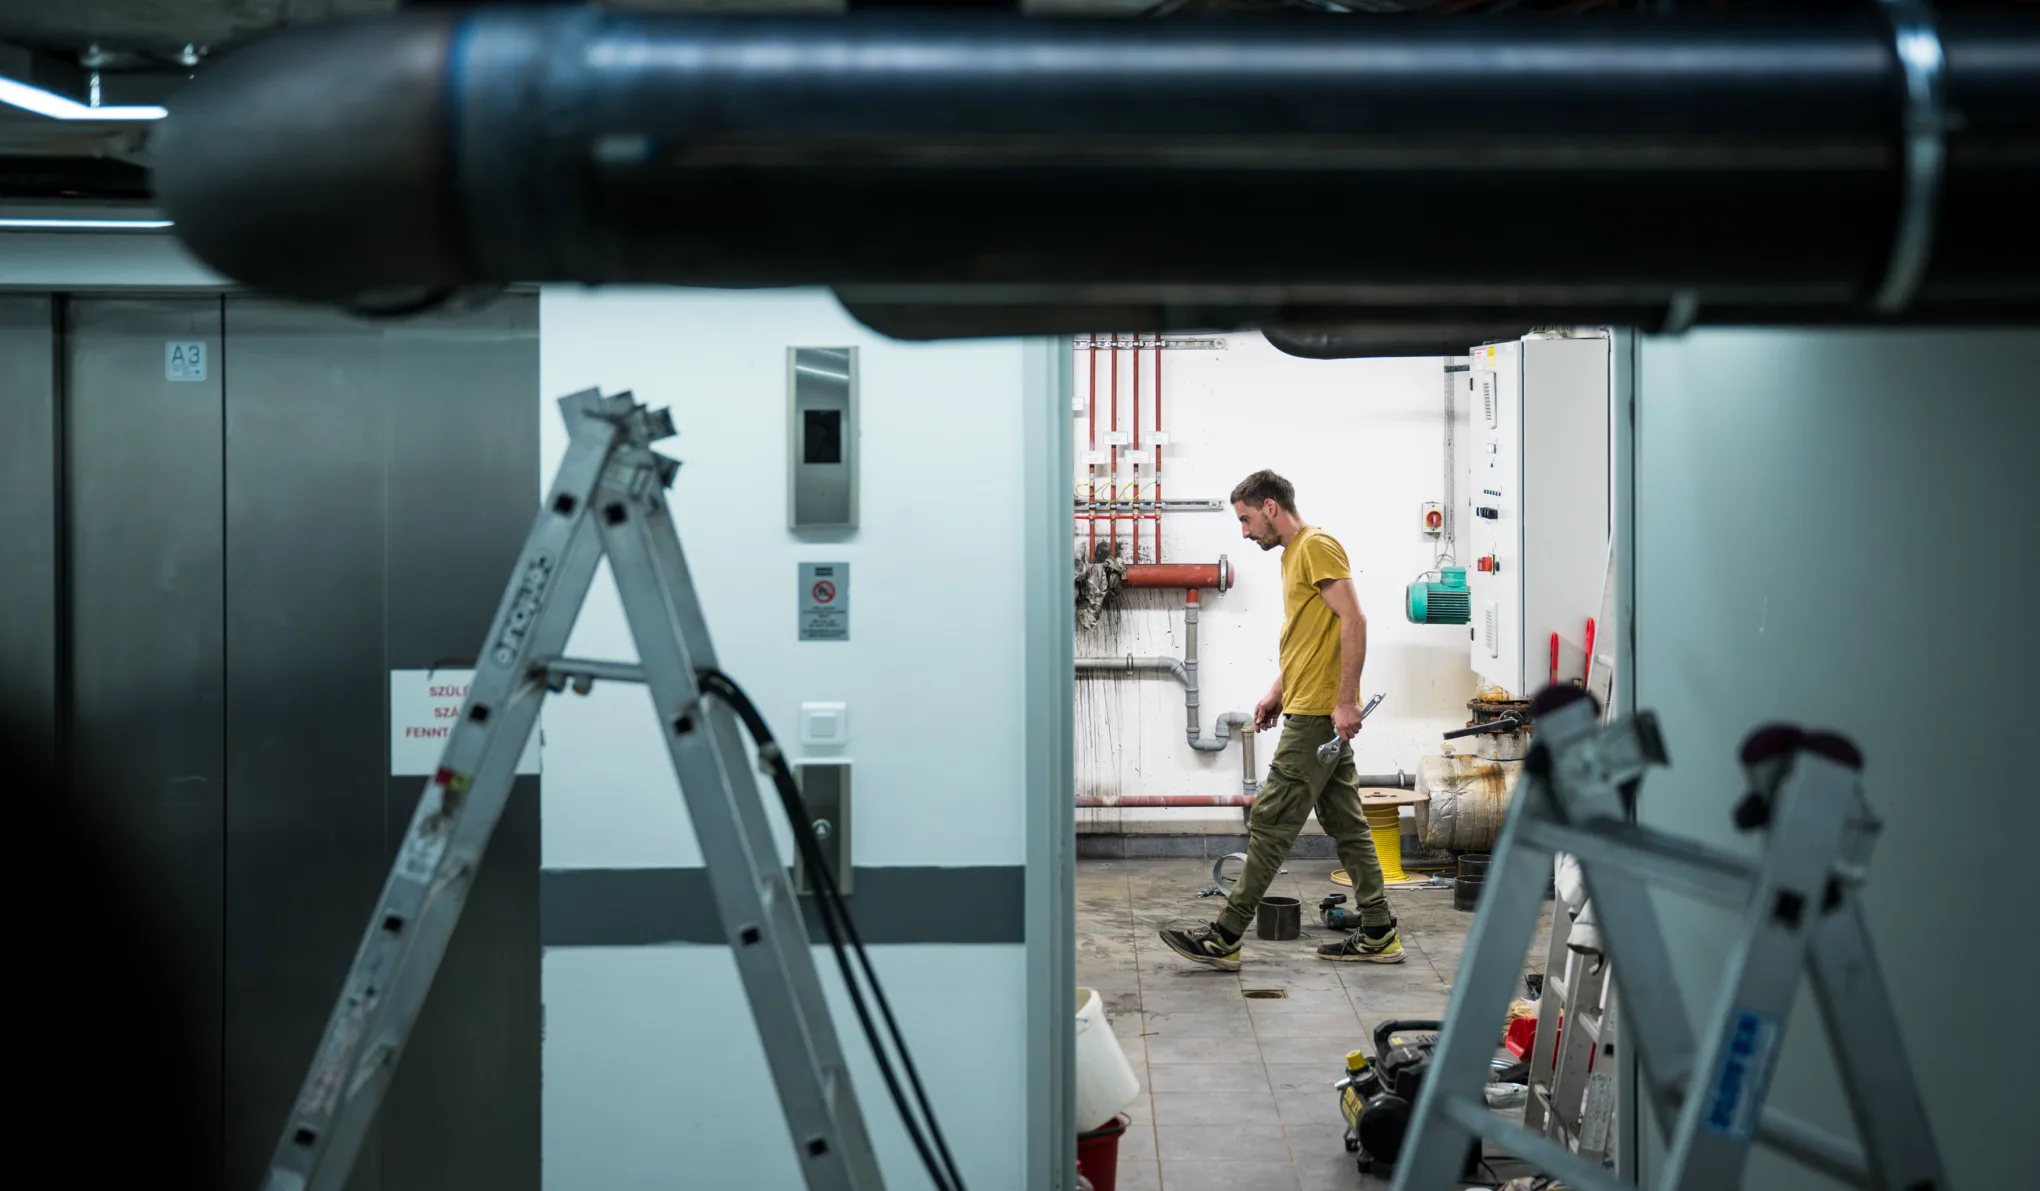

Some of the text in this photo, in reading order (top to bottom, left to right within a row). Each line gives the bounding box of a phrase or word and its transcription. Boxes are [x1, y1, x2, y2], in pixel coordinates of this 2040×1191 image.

[171, 345, 200, 364] A3
[434, 705, 460, 718] SZÁ
[406, 726, 449, 738] FENNT
